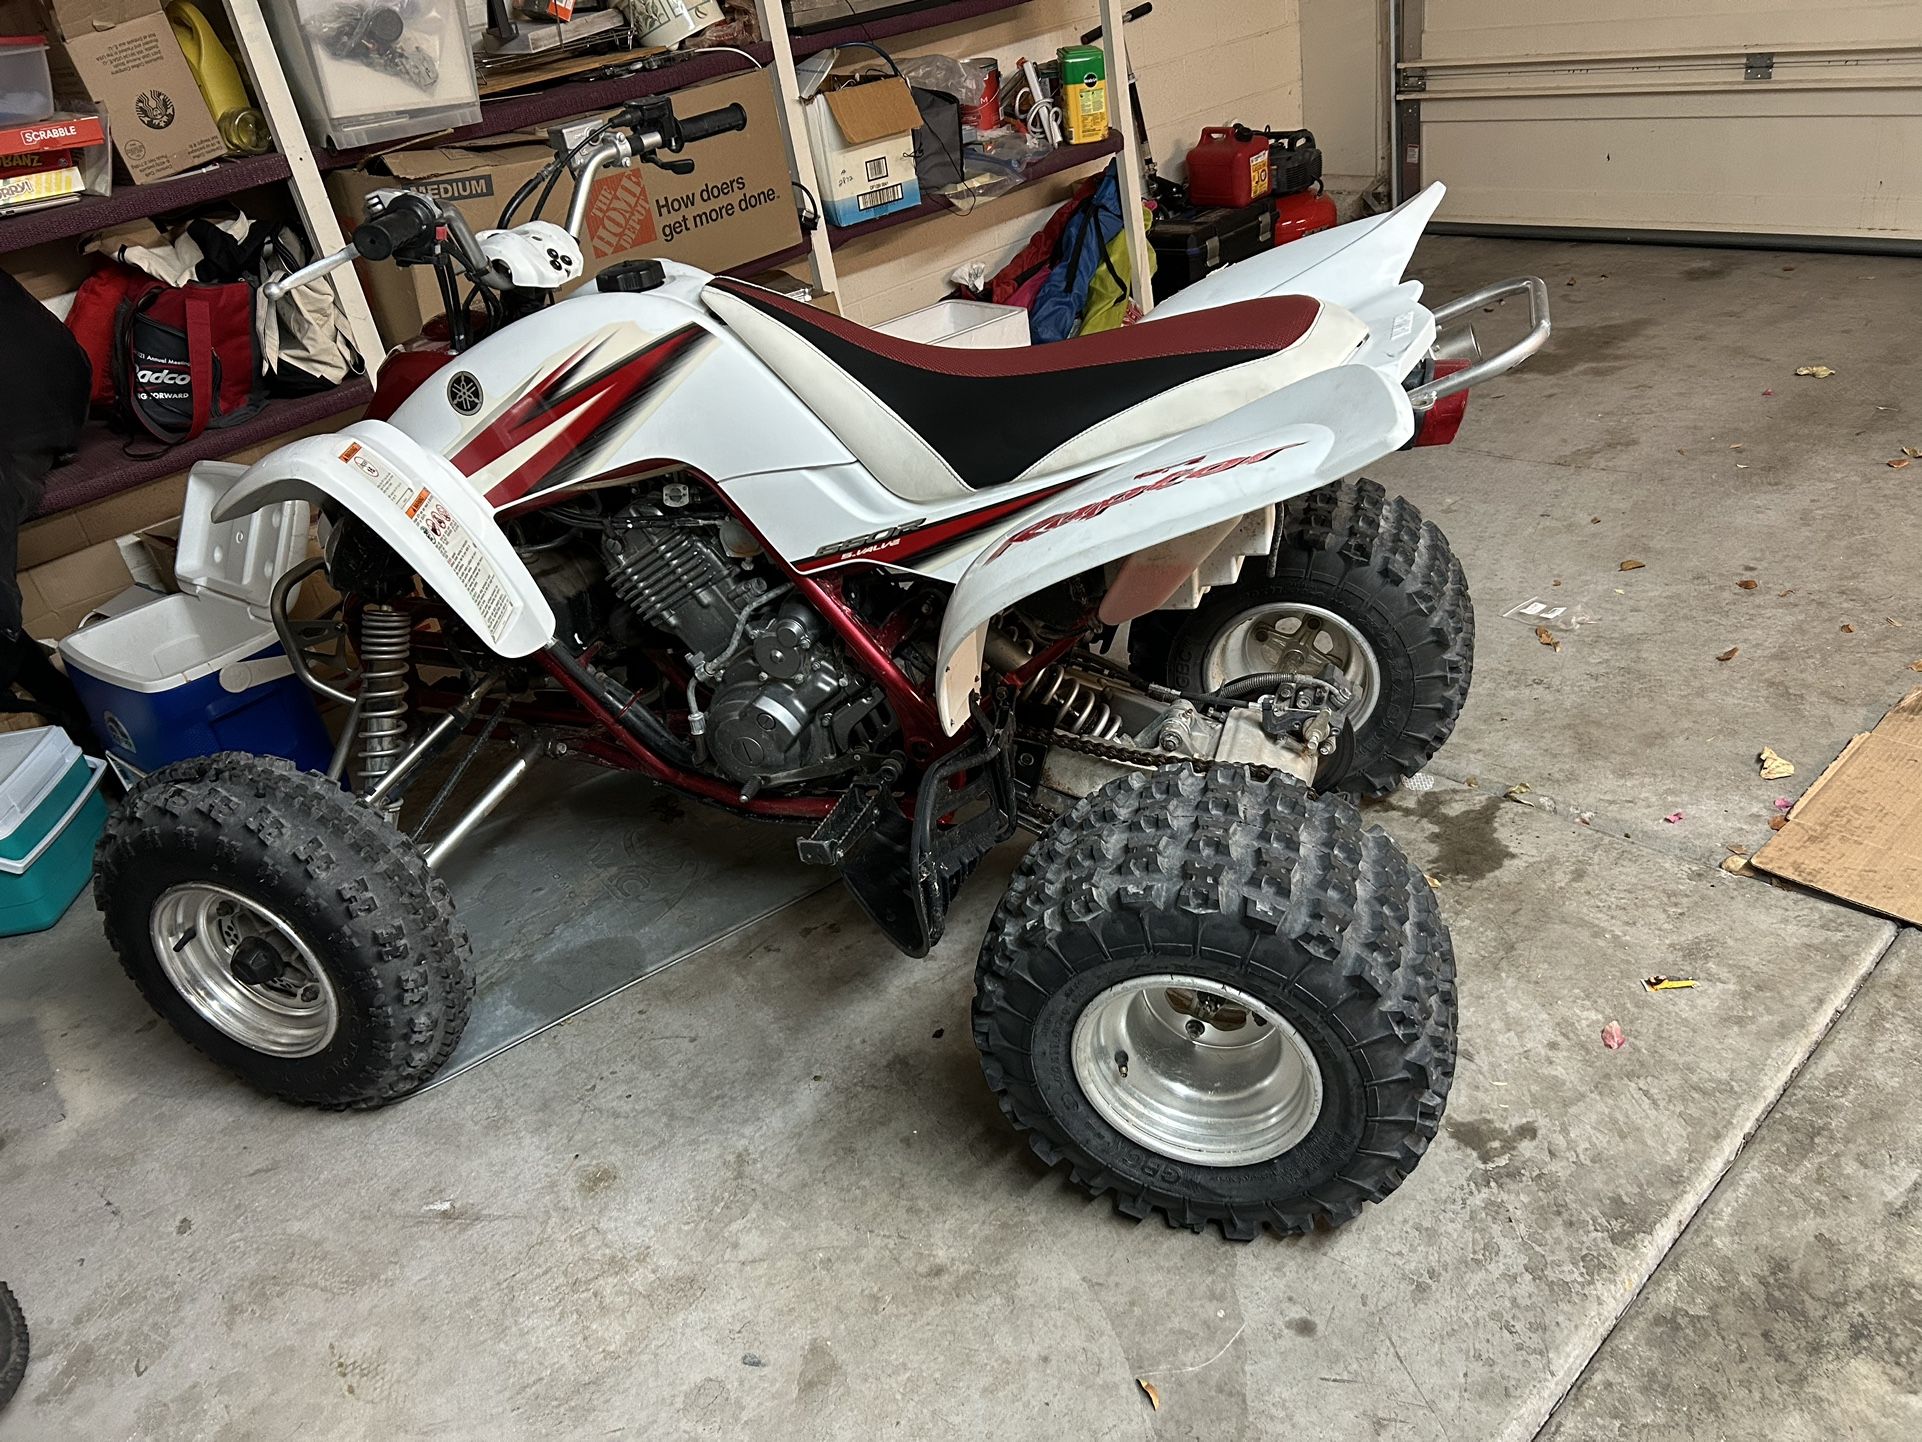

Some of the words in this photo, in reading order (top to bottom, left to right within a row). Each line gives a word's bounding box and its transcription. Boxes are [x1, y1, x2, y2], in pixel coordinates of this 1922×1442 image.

[24, 125, 77, 142] SCRABBLE
[410, 179, 487, 199] MEDIUM
[591, 186, 615, 217] THE
[655, 192, 695, 217] How
[700, 176, 746, 203] doers
[592, 171, 644, 254] HOME
[662, 214, 690, 242] get
[692, 203, 735, 228] more
[146, 355, 167, 364] Annual
[814, 518, 927, 557] 660R
